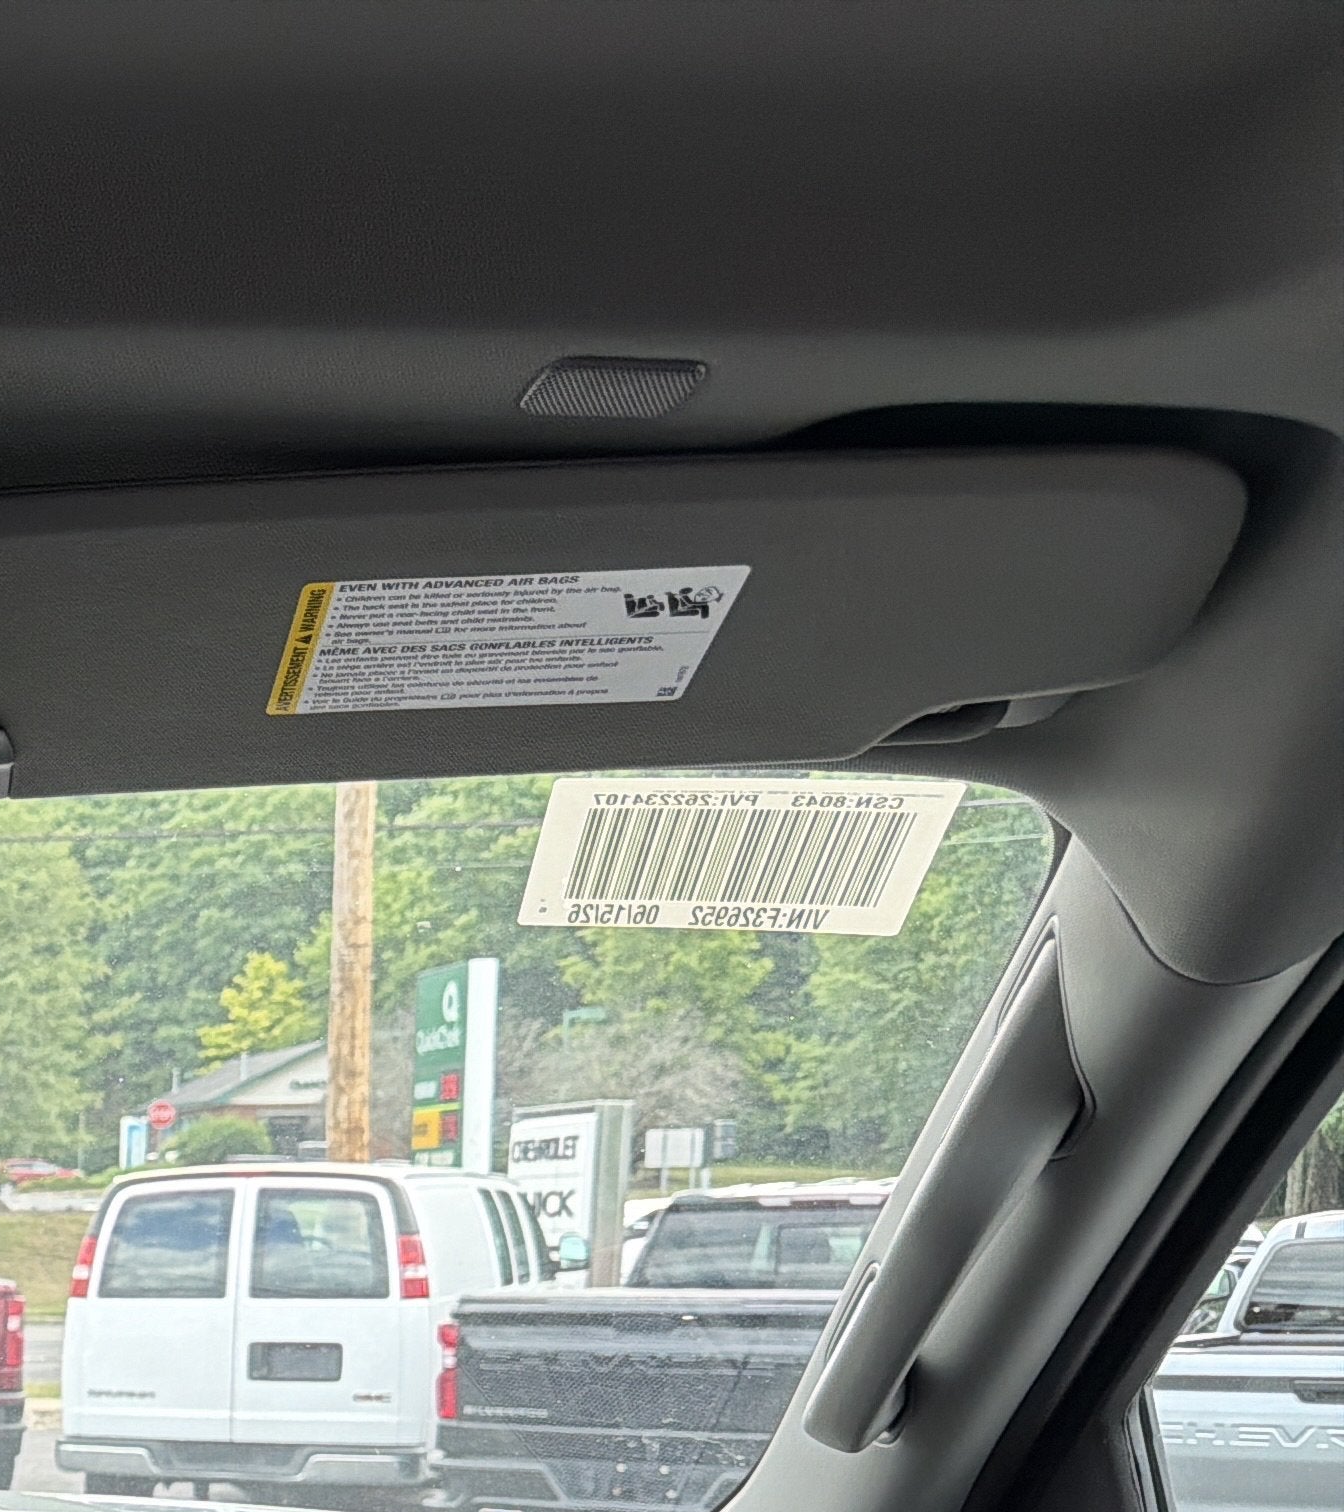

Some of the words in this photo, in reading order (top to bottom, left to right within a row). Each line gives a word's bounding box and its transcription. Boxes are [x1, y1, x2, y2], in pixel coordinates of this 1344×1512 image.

[338, 583, 377, 593] EVEN
[381, 582, 419, 591] WITH
[422, 578, 504, 590] ADVANCED
[509, 577, 534, 587] AIR
[538, 576, 580, 586] BAGS
[299, 588, 327, 633] WARNING
[362, 645, 397, 655] AVEC
[401, 645, 427, 653] DES
[430, 643, 465, 652] SACS
[469, 640, 557, 651] GONFLABLES
[560, 636, 655, 648] INTELLIGENTS
